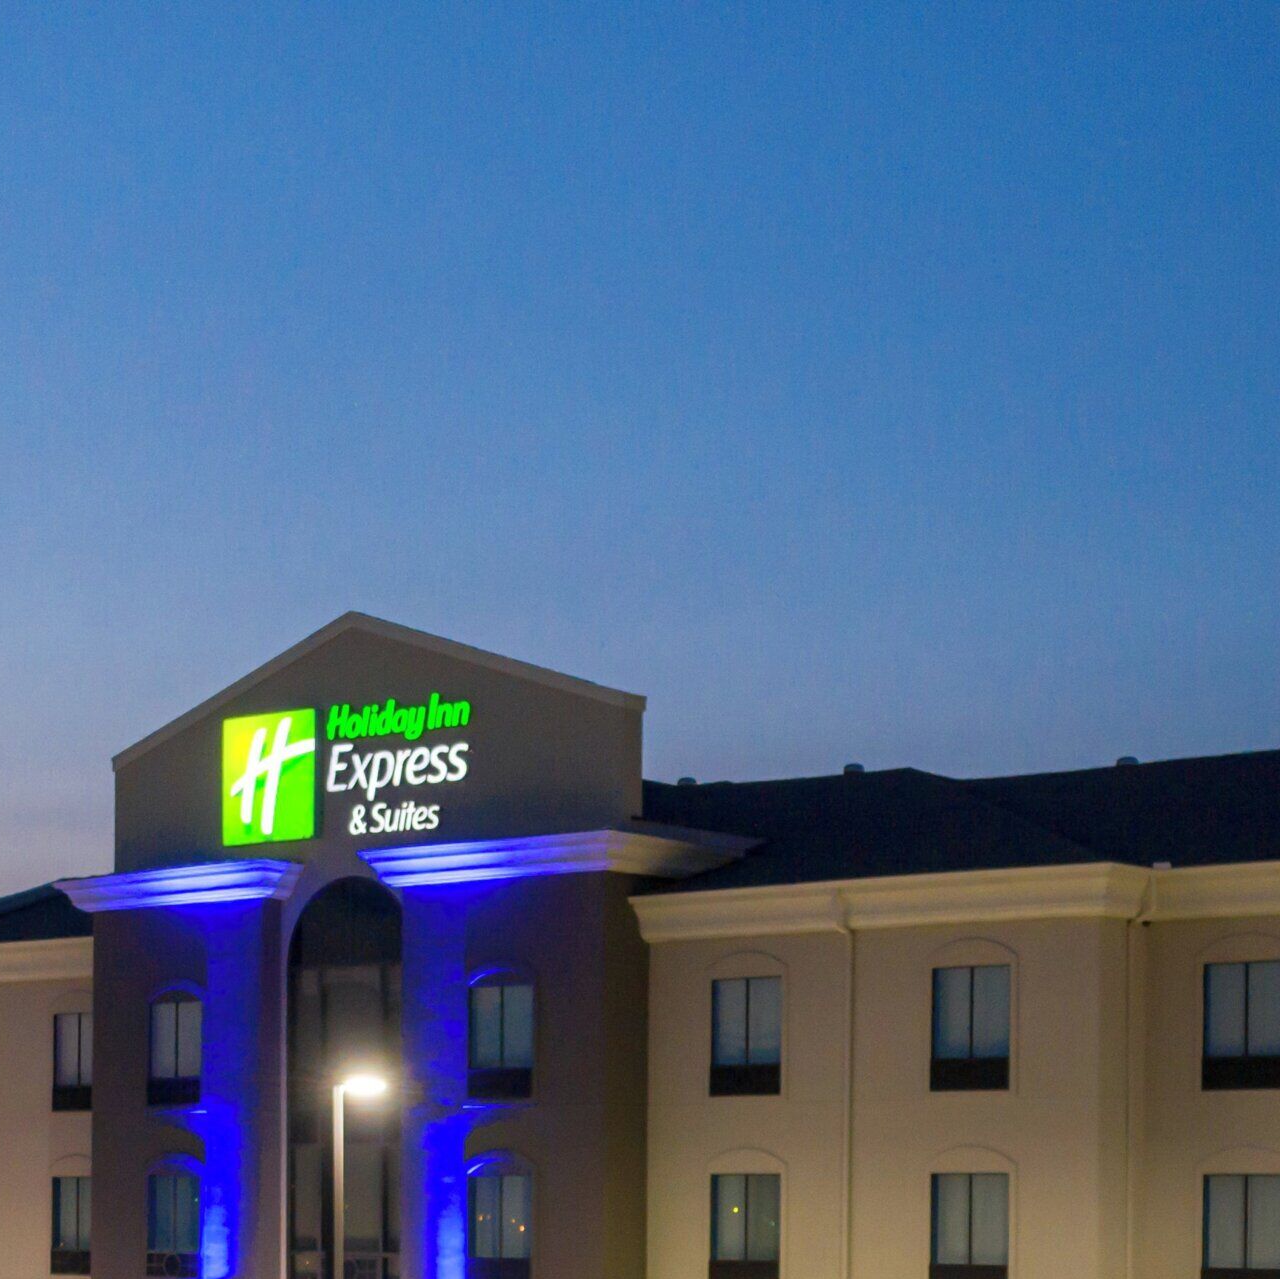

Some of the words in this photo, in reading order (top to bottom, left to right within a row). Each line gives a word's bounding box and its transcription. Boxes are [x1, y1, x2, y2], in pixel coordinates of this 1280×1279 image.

[326, 698, 426, 740] Holiday
[427, 692, 470, 730] Inn
[326, 742, 469, 801] Express
[349, 804, 367, 835] &
[369, 801, 440, 833] Suites
